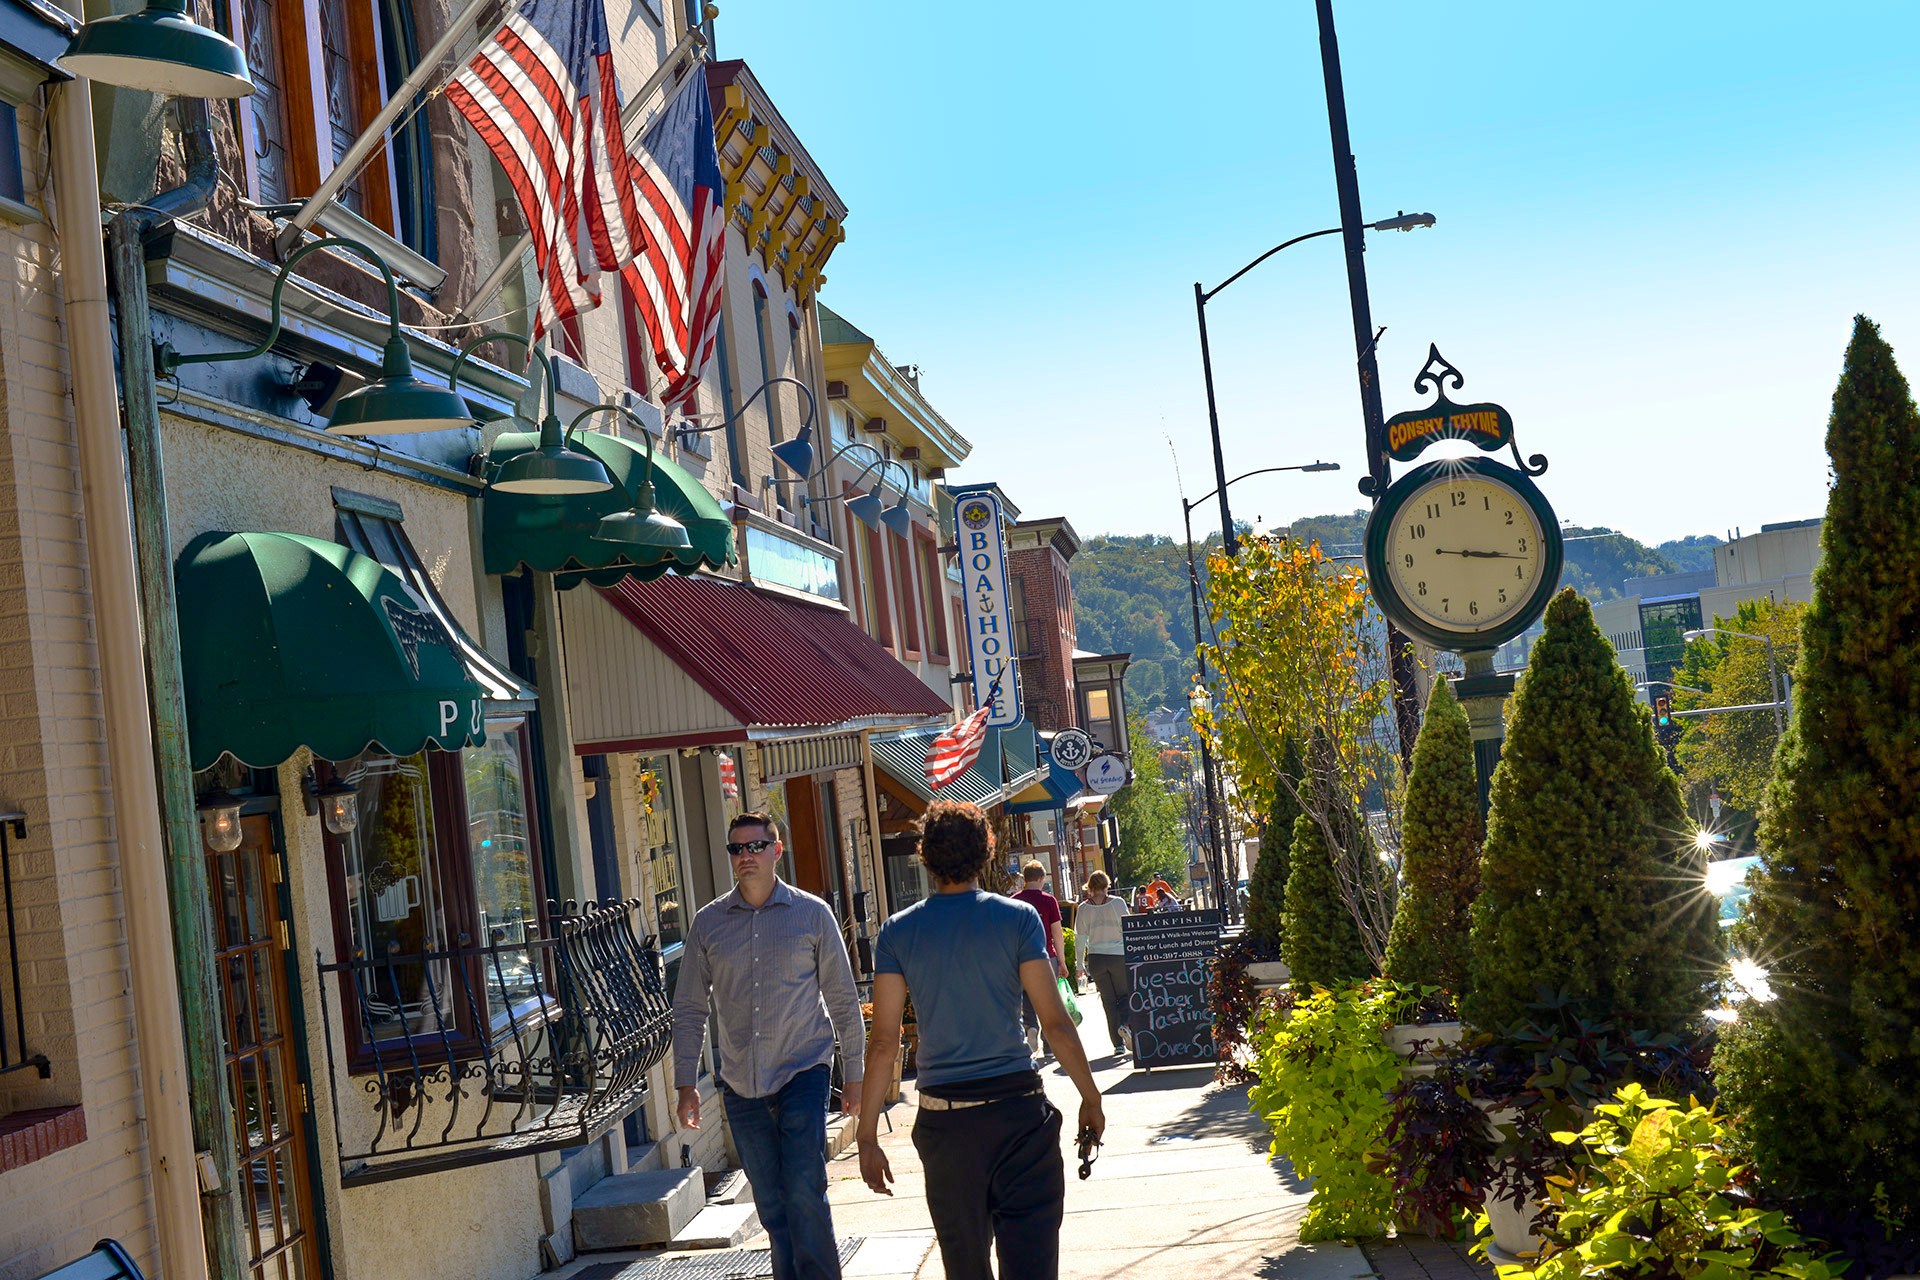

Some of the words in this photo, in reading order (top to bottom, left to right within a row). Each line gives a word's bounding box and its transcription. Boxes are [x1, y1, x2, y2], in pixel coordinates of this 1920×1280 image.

[1389, 417, 1444, 452] CONSHY
[1450, 411, 1501, 438] THYME
[1451, 491, 1466, 507] 12
[1484, 497, 1490, 511] 1
[1426, 504, 1441, 519] 11
[1504, 511, 1514, 525] 2
[1410, 524, 1425, 540] 10
[1518, 538, 1527, 553] 3
[1405, 554, 1414, 569] 9
[1514, 565, 1523, 580] 4
[1418, 581, 1427, 597] 8
[1498, 589, 1507, 604] 5
[1441, 598, 1449, 613] 7
[1469, 601, 1478, 616] 6
[1138, 897, 1148, 907] 19
[1127, 916, 1202, 929] BLACKFISH
[1126, 934, 1160, 942] Reservations
[1126, 945, 1145, 953] Open
[1159, 942, 1179, 950] Lunch
[1194, 939, 1218, 947] Dinner
[1143, 950, 1203, 962] 610-397-0888
[1129, 961, 1215, 991] Tuesday
[1129, 987, 1193, 1012] October
[1148, 1006, 1215, 1031] Tasting
[1135, 1030, 1190, 1061] Dover
